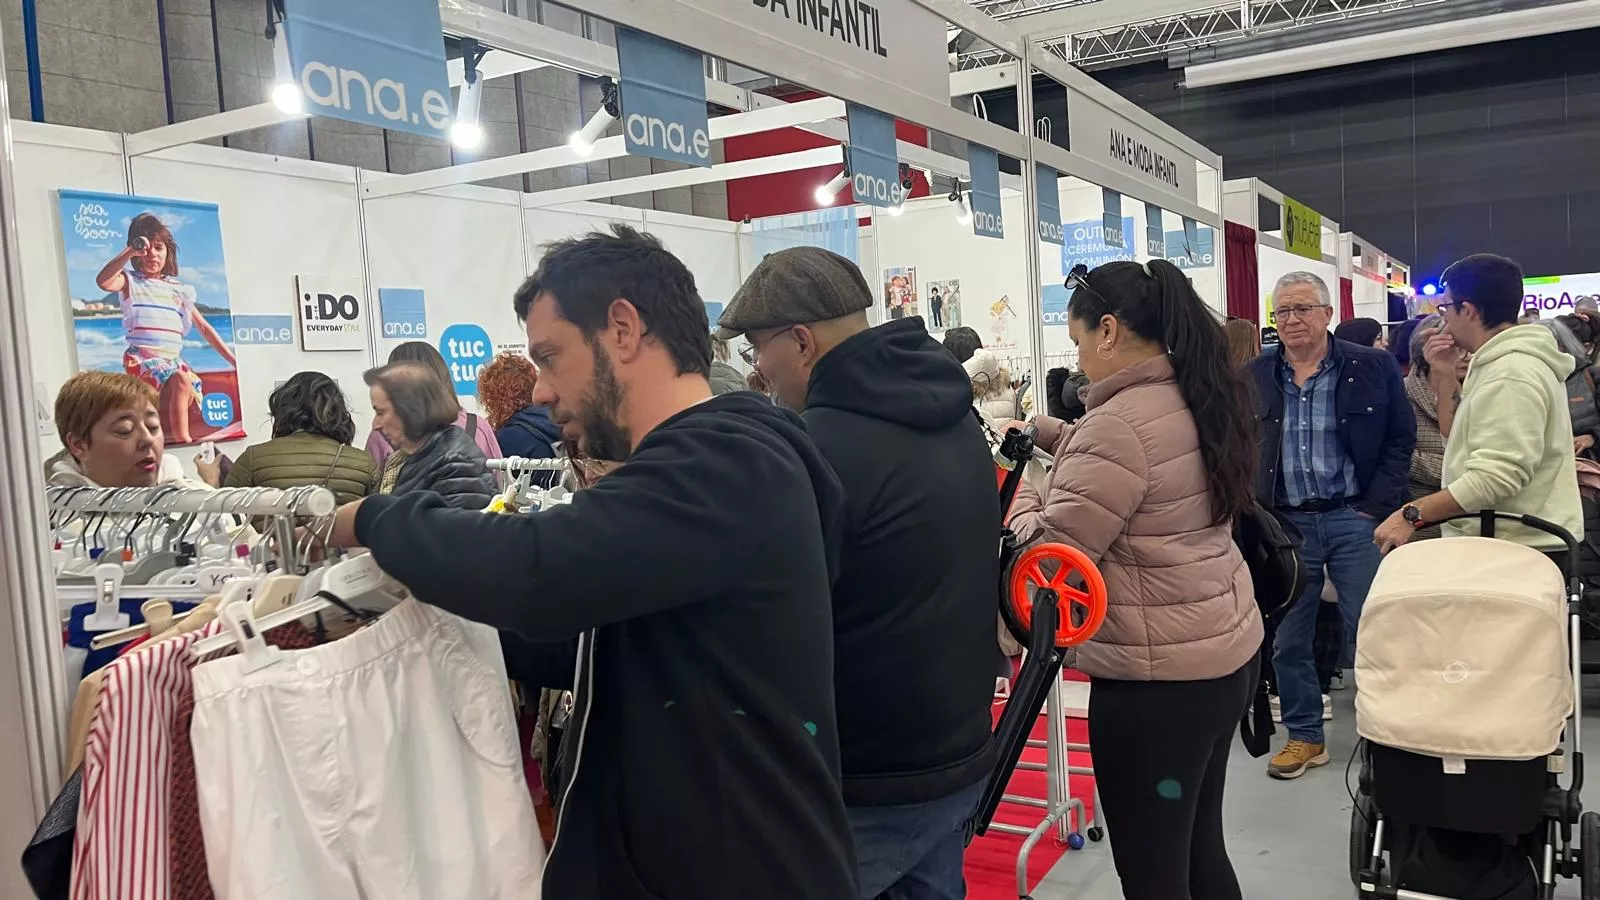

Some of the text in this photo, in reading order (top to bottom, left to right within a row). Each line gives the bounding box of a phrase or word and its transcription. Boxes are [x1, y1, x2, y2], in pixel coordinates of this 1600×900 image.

[796, 0, 888, 57] INFANTIL
[302, 61, 450, 130] ana.e
[627, 113, 710, 159] ana.e
[1110, 128, 1179, 188] ANA E MODA INFANTIL
[854, 172, 900, 204] ana.e
[73, 214, 110, 233] you
[974, 210, 1003, 233] ana.e
[1039, 220, 1064, 240] ana.e
[80, 228, 123, 239] soon
[1104, 226, 1123, 244] ana.e
[236, 327, 291, 342] ana.e
[306, 324, 343, 332] EVERYDAY
[385, 322, 425, 335] ana.e
[448, 337, 485, 359] tuc
[207, 399, 228, 409] tuc
[208, 410, 229, 421] tuc
